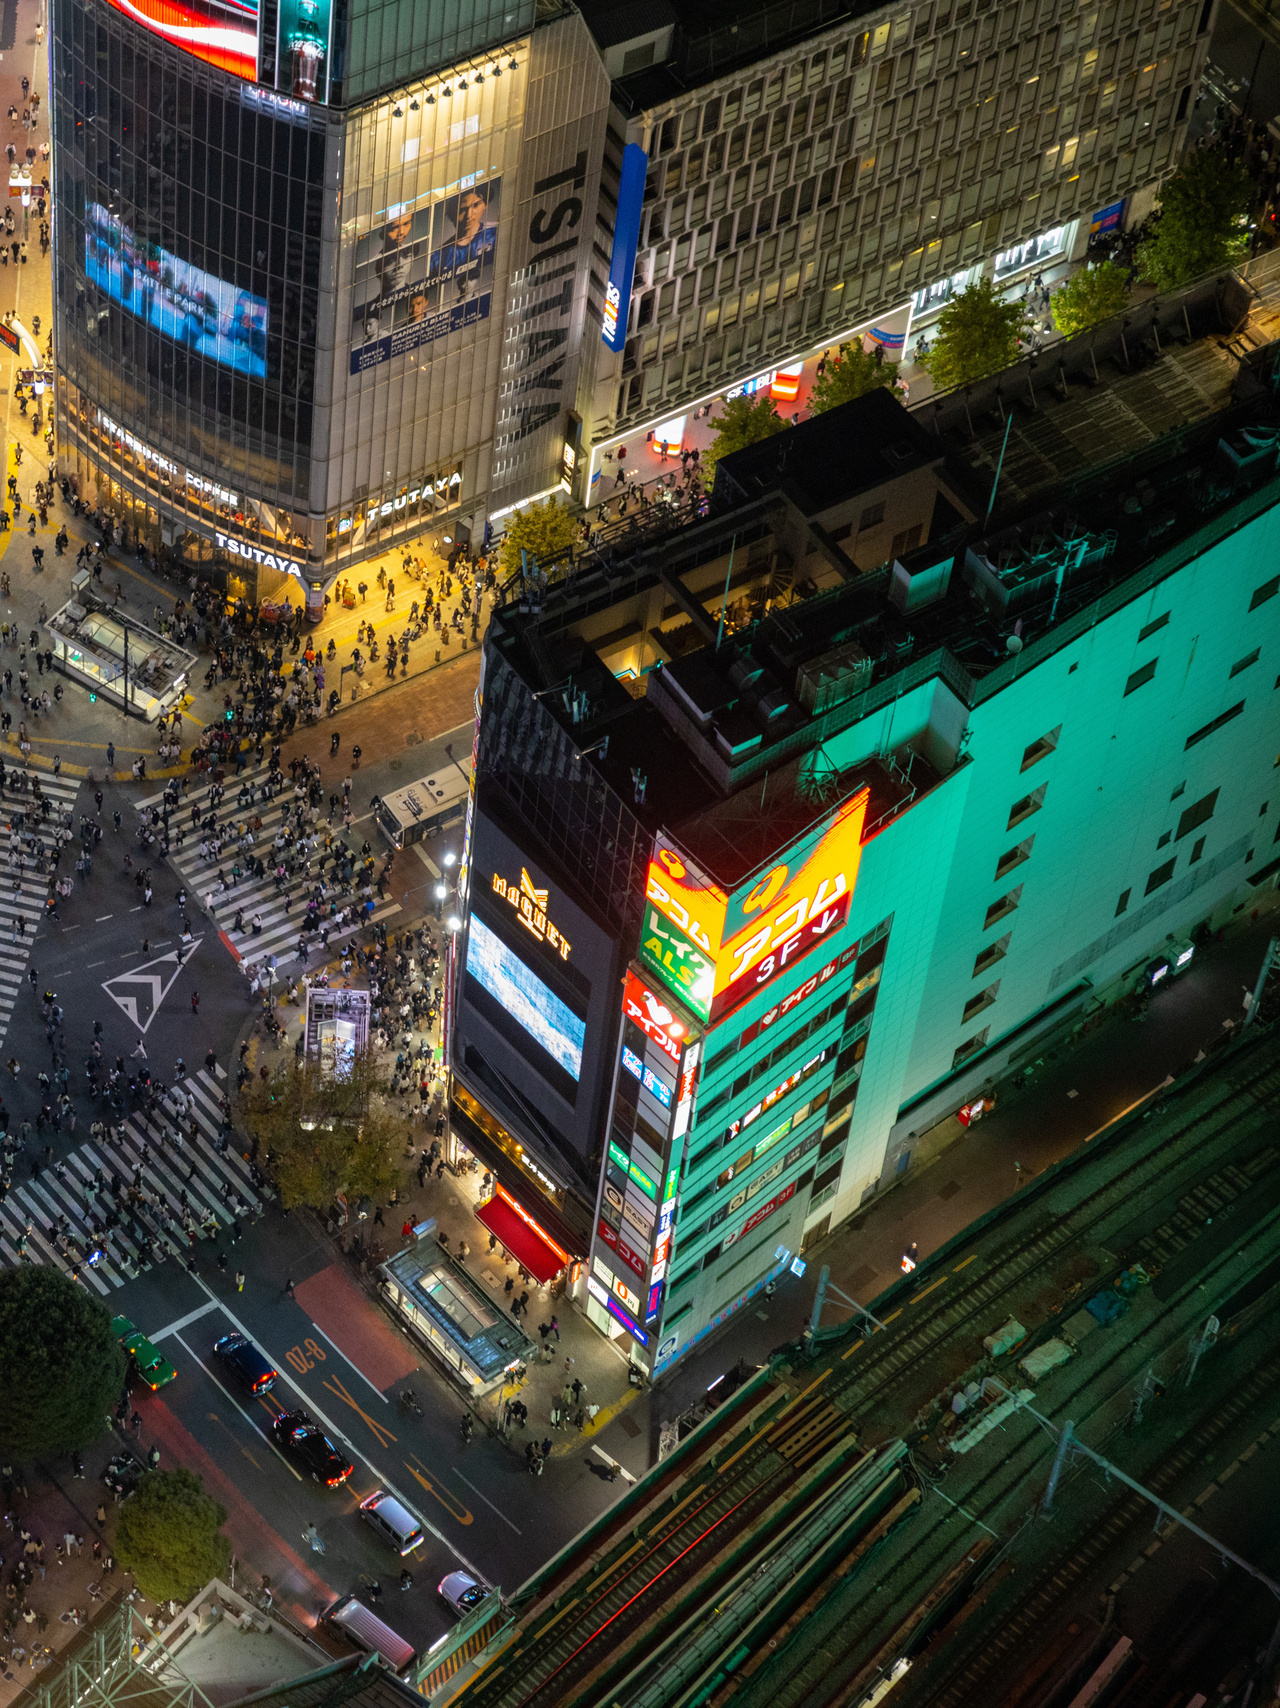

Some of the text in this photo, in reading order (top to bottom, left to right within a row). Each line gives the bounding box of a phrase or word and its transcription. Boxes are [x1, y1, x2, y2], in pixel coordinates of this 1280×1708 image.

[134, 268, 206, 316] BATTLE PARK
[513, 150, 588, 440] TSUTAYA
[391, 322, 430, 341] SAMURAI
[430, 312, 451, 327] BLUE
[102, 416, 238, 507] STARBUCKS COFFEE
[367, 472, 464, 522] TSUTAYA
[215, 532, 302, 578] TSUTAYA
[492, 871, 572, 961] MAGNET
[646, 876, 711, 951] アコム
[729, 872, 847, 982] アコム
[644, 936, 699, 990] ALS
[648, 910, 715, 978] レイク
[756, 932, 802, 983] 3F
[780, 962, 836, 1014] アイフル
[626, 998, 681, 1061] アイフル
[609, 1143, 652, 1191] レイク ALSA
[624, 1204, 650, 1233] EAST
[747, 1203, 775, 1231] アコム
[603, 1226, 644, 1274] アコム
[285, 1337, 327, 1374] 8-20
